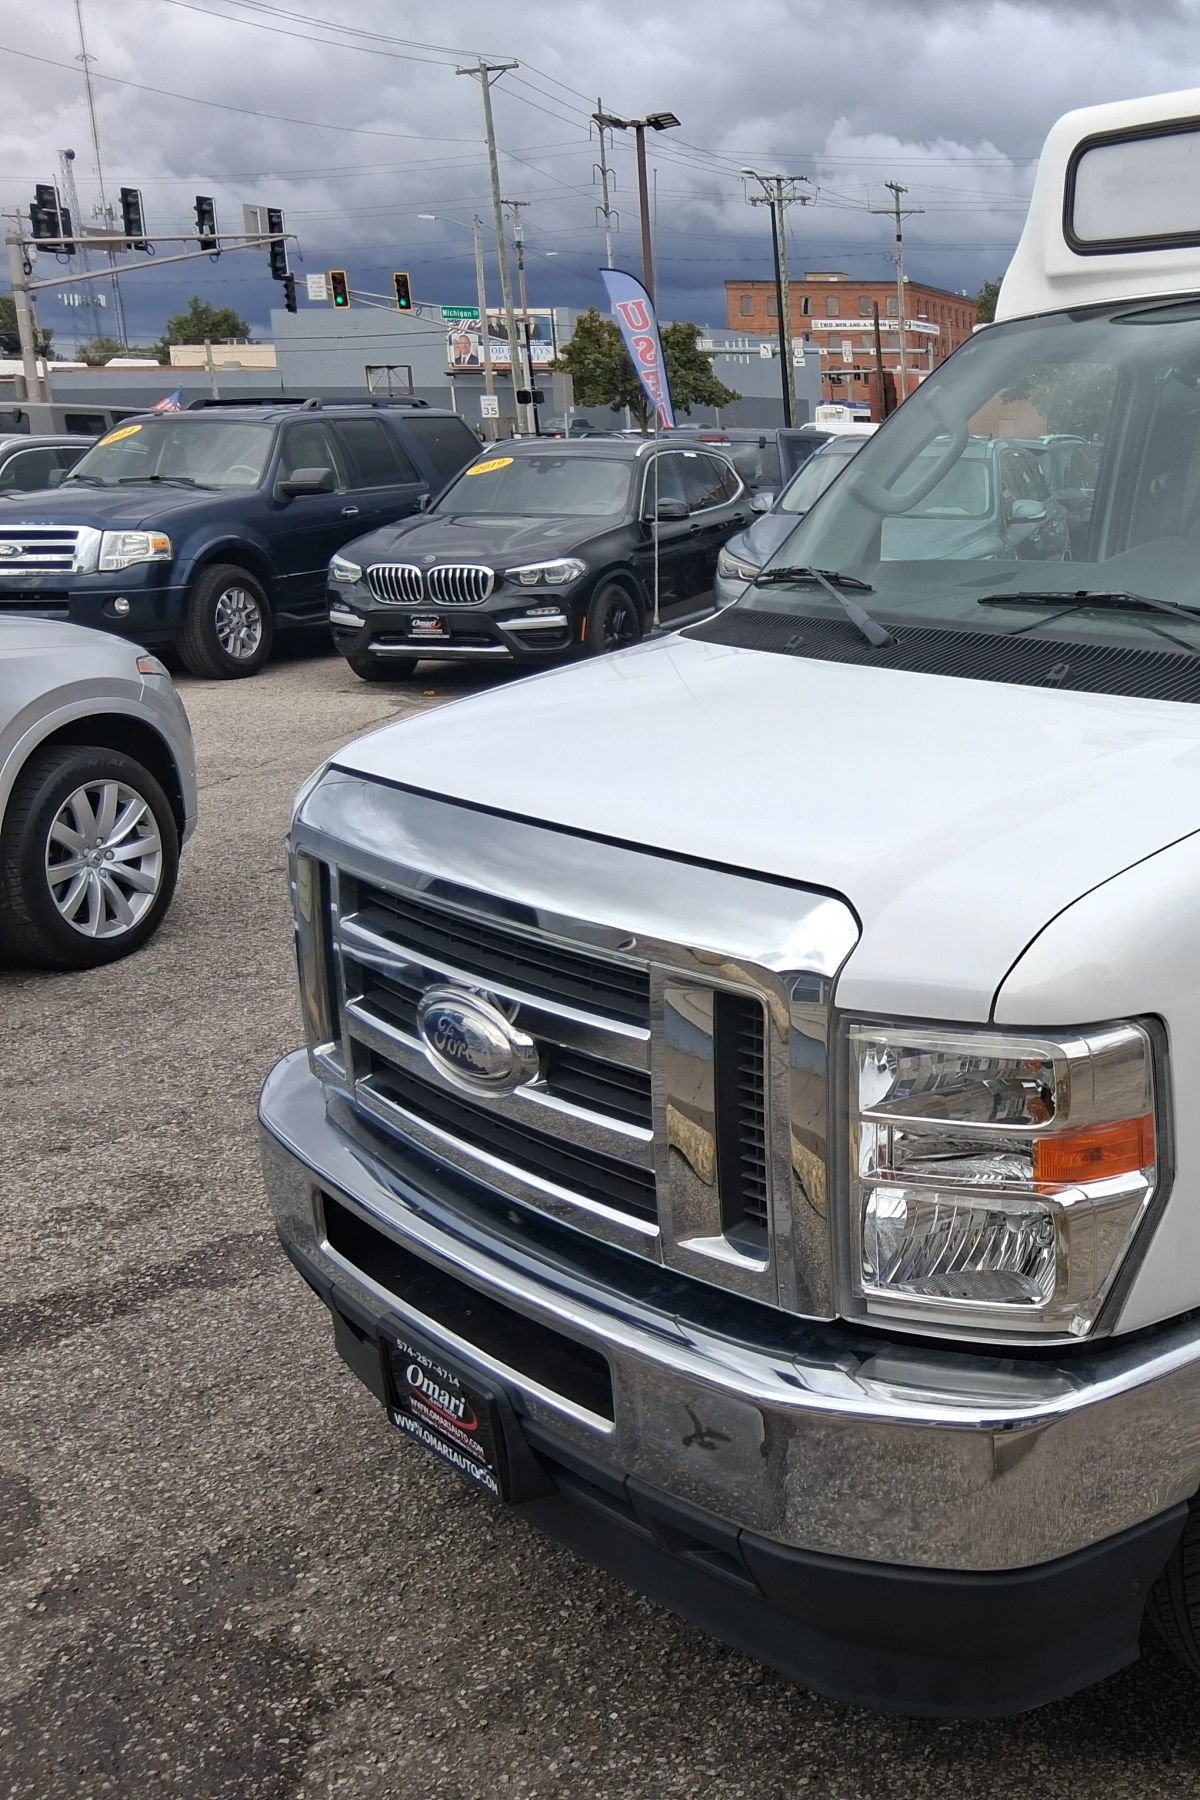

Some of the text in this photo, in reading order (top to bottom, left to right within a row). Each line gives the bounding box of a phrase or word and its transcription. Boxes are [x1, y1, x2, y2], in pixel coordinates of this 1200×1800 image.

[442, 309, 471, 317] Michigan
[483, 407, 497, 415] 35
[396, 1338, 460, 1388] 574-287-4714
[406, 1364, 467, 1419] Omari
